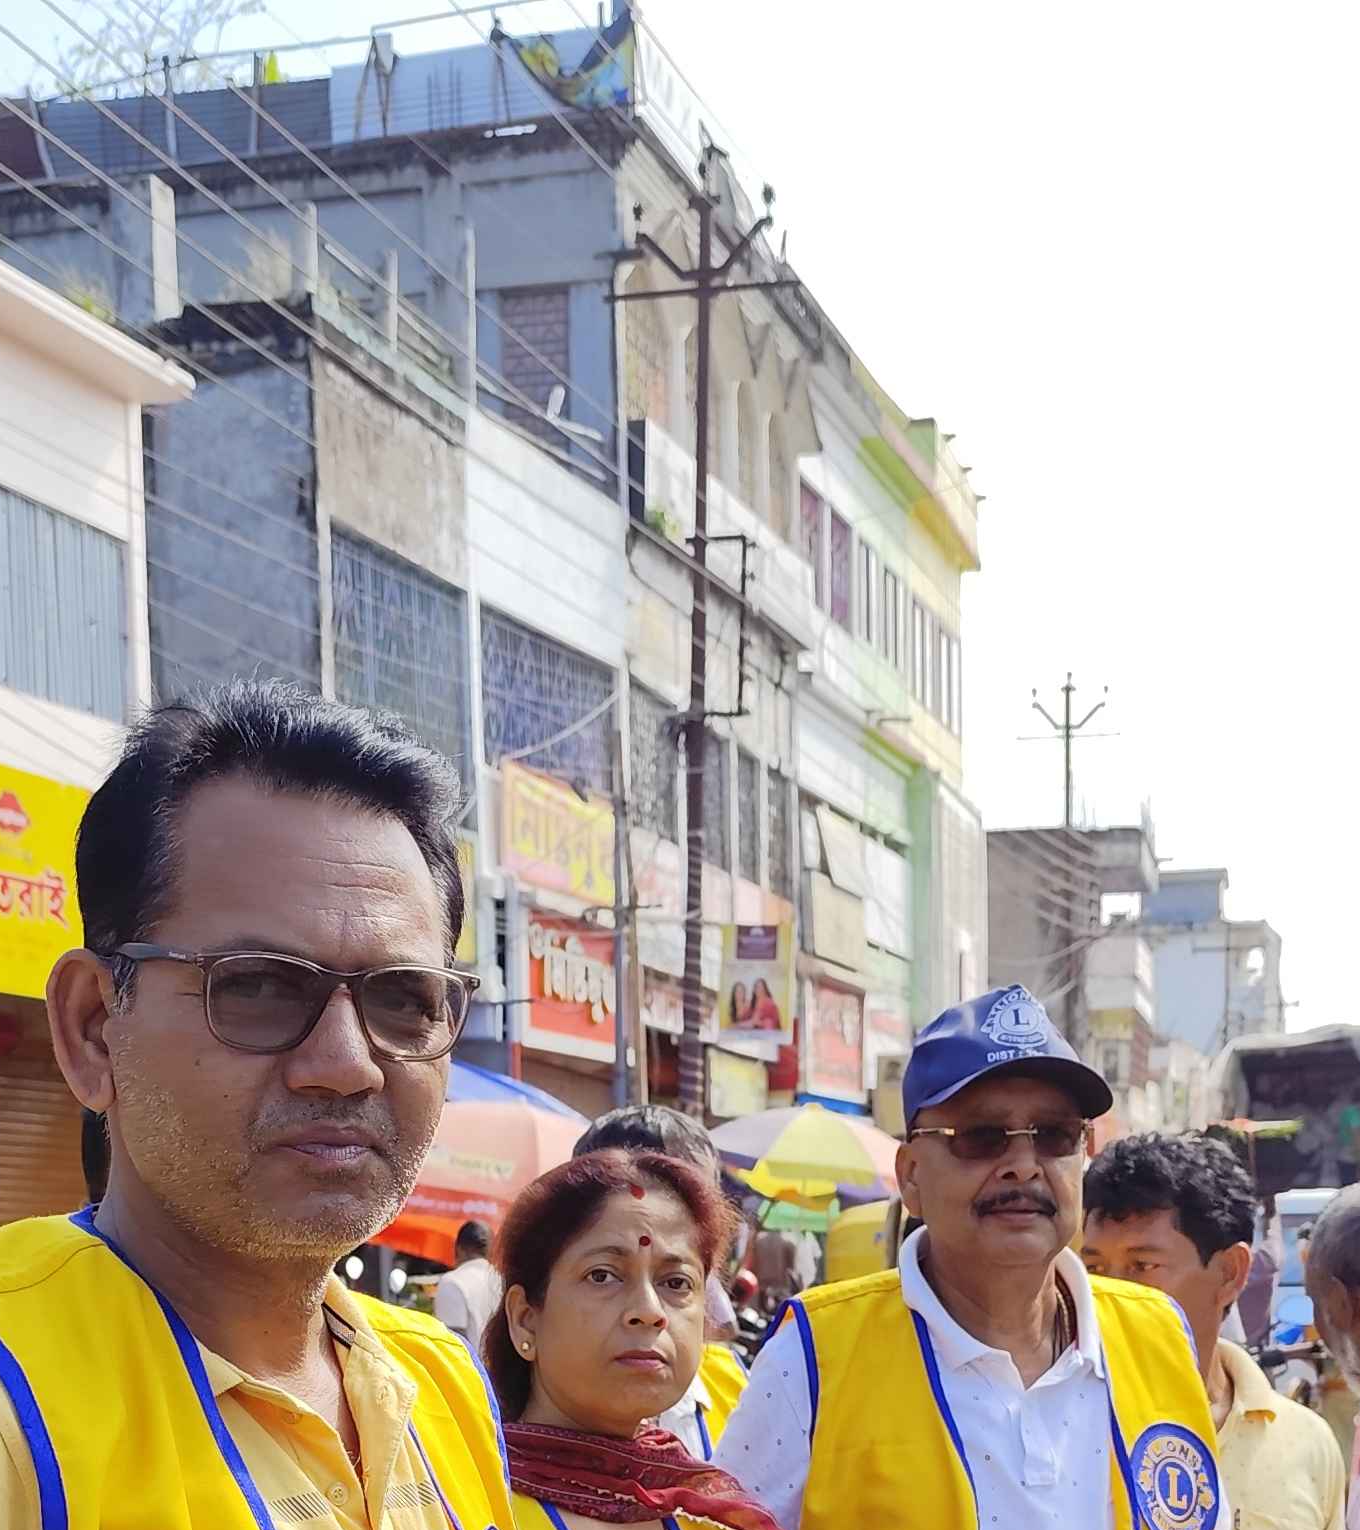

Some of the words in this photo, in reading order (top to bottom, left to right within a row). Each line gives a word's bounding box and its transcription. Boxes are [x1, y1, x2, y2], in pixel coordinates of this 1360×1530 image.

[1011, 1008, 1030, 1026] L
[986, 1049, 1016, 1063] DIST
[1166, 1466, 1188, 1511] L
